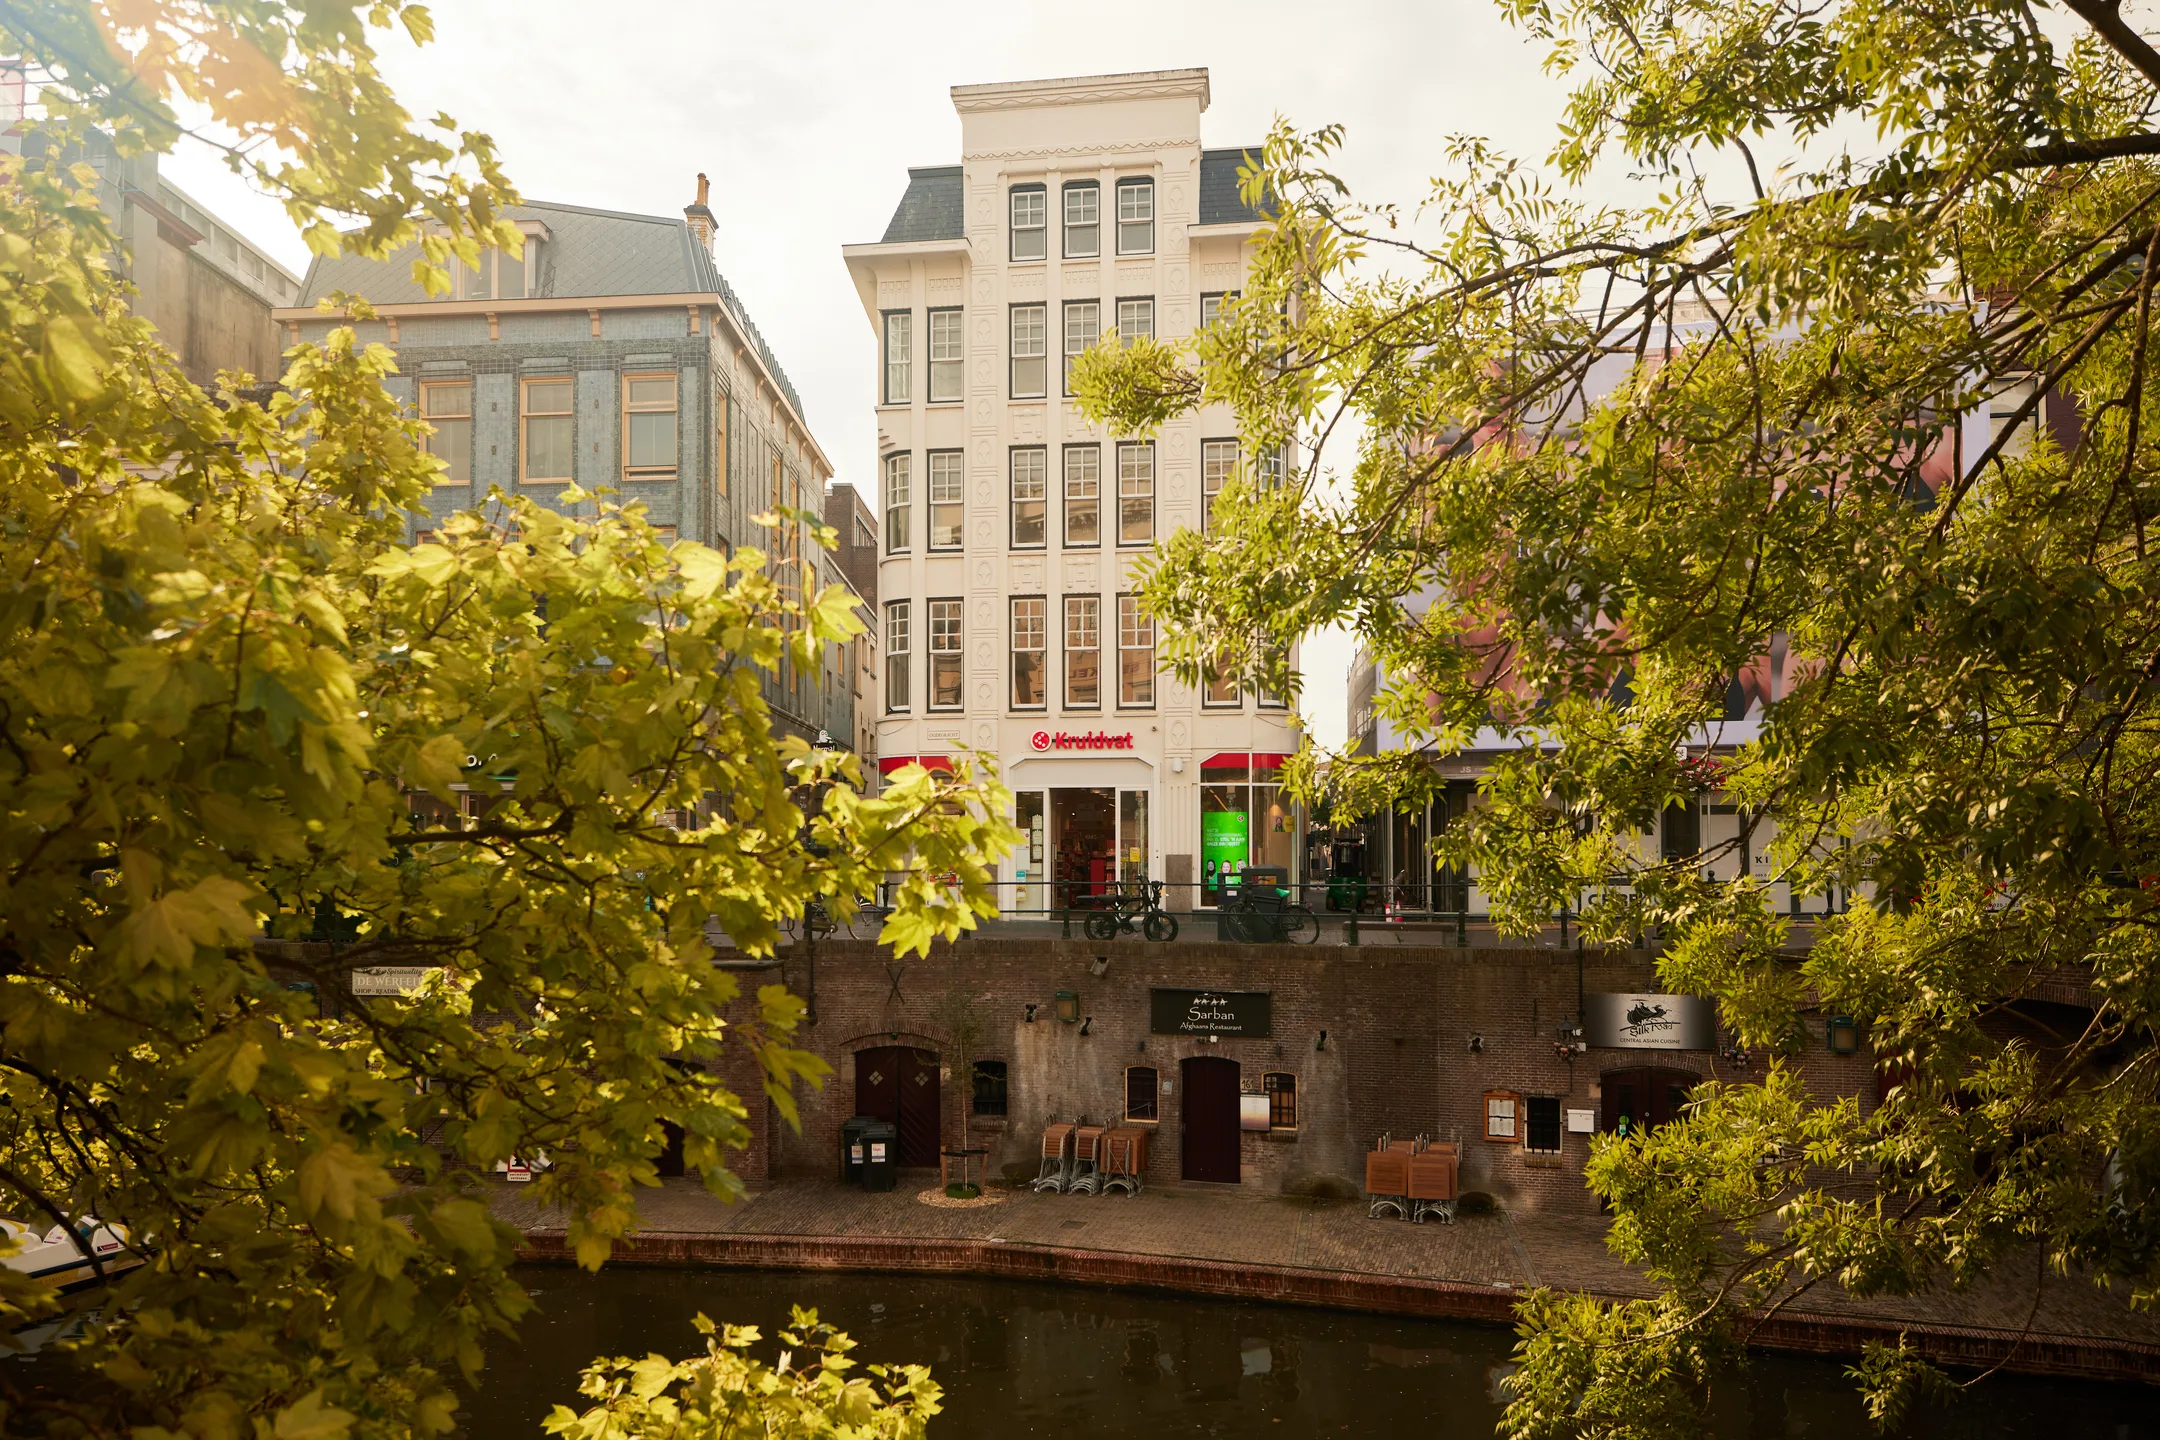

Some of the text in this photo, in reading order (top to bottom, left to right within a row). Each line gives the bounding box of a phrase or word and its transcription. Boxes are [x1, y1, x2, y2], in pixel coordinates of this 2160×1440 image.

[1055, 731, 1133, 749] Kruidvat
[356, 976, 373, 986] DE
[1187, 1006, 1235, 1021] Sarban
[1180, 1022, 1242, 1031] Afghaans Restaurant
[1629, 1024, 1650, 1037] Silk
